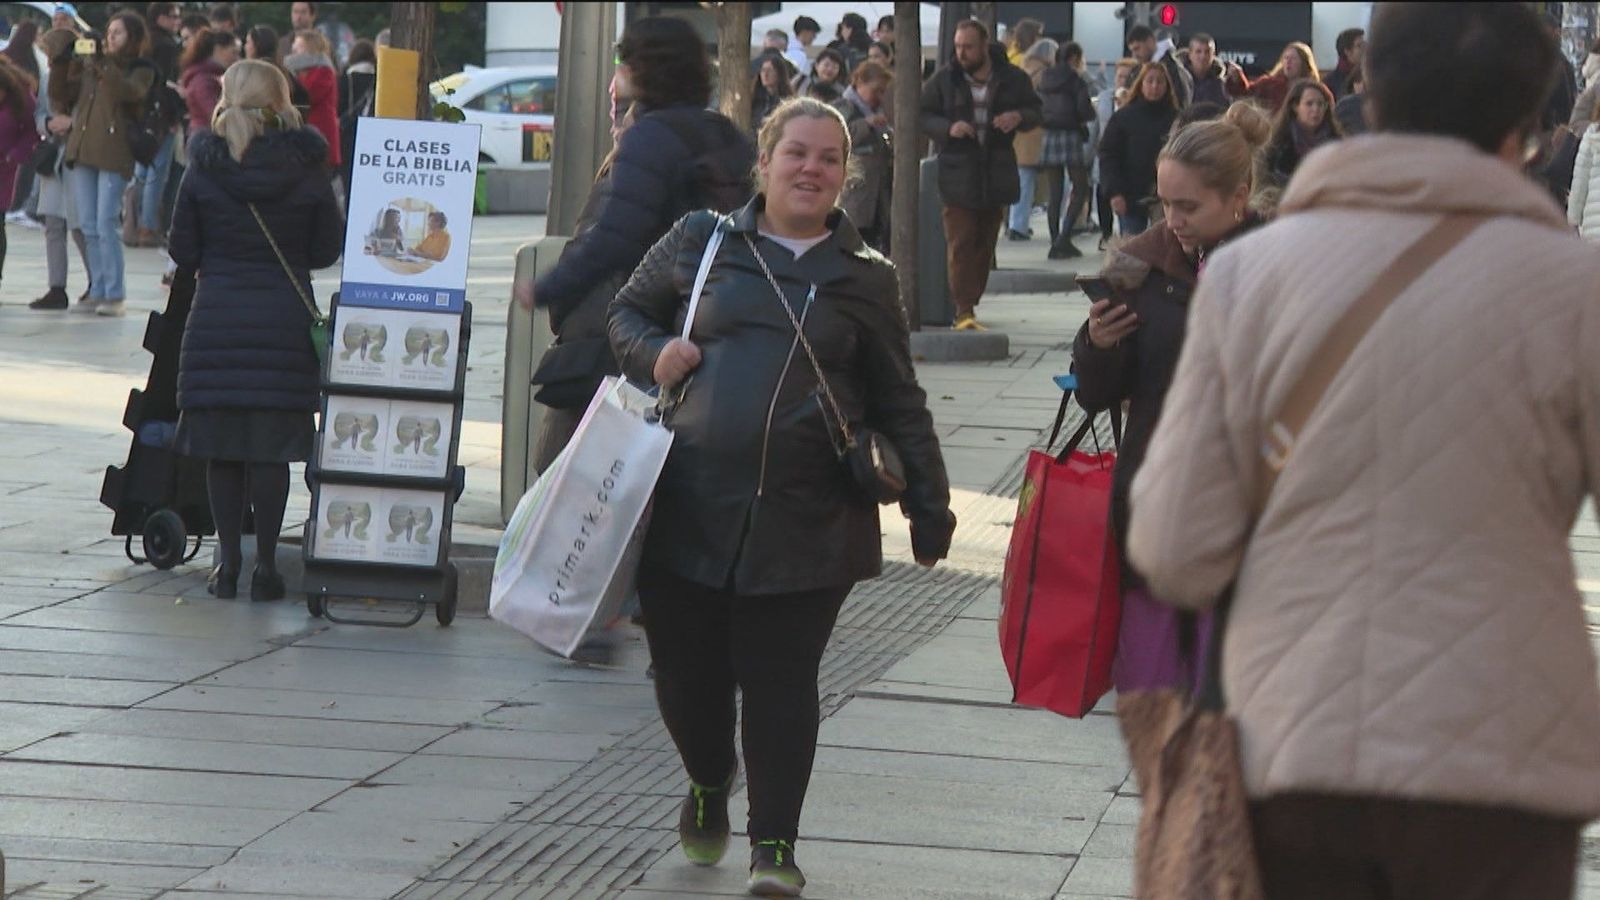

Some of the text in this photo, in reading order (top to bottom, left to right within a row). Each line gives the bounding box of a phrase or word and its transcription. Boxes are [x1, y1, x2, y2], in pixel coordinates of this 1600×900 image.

[384, 139, 451, 155] CLASES
[359, 153, 472, 173] DE LA BIBLIA
[383, 171, 445, 187] GRATIS
[354, 288, 429, 304] VAYA A JW.ORG
[549, 458, 625, 606] primark.com
